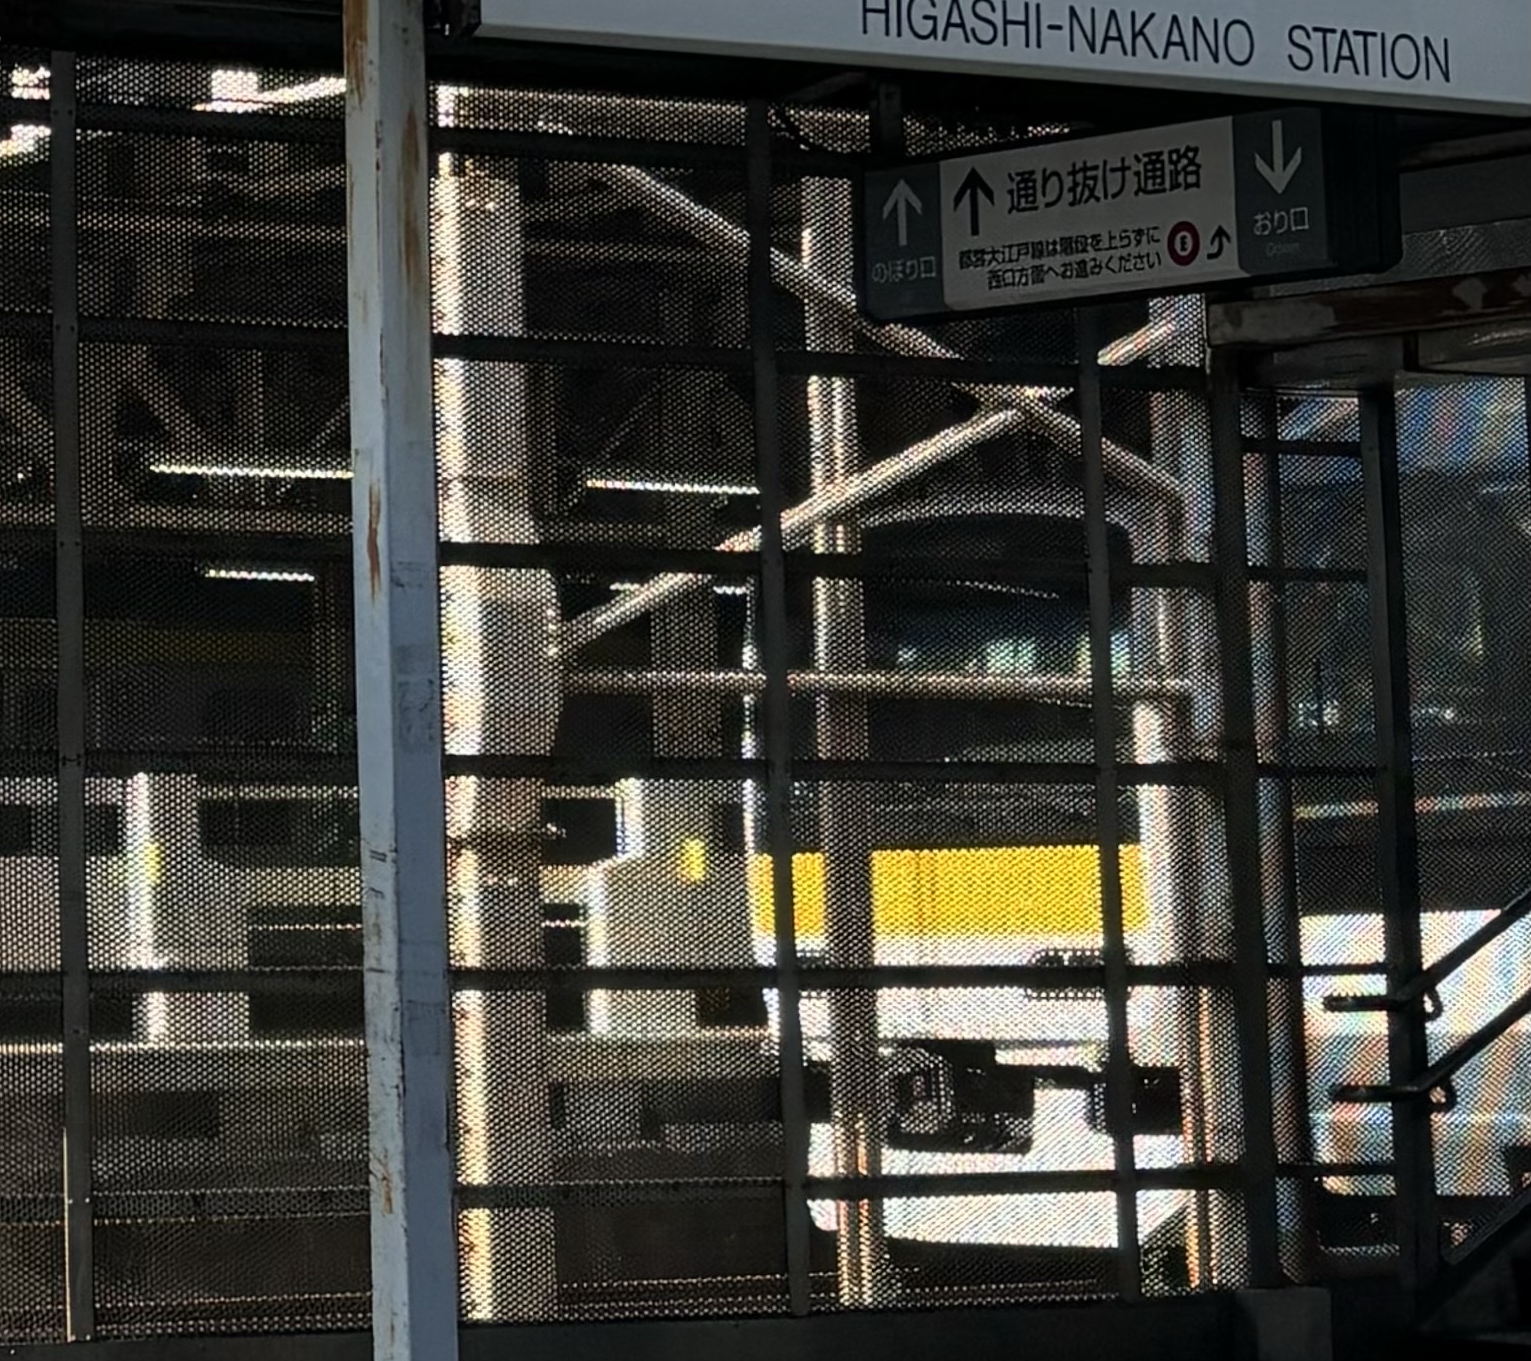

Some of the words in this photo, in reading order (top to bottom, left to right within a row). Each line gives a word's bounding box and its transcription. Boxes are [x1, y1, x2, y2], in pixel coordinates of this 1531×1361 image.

[1287, 24, 1451, 83] STATION
[1005, 144, 1203, 216] 通り抜け通路
[1252, 206, 1310, 236] おり口
[871, 255, 938, 284] のぼり口
